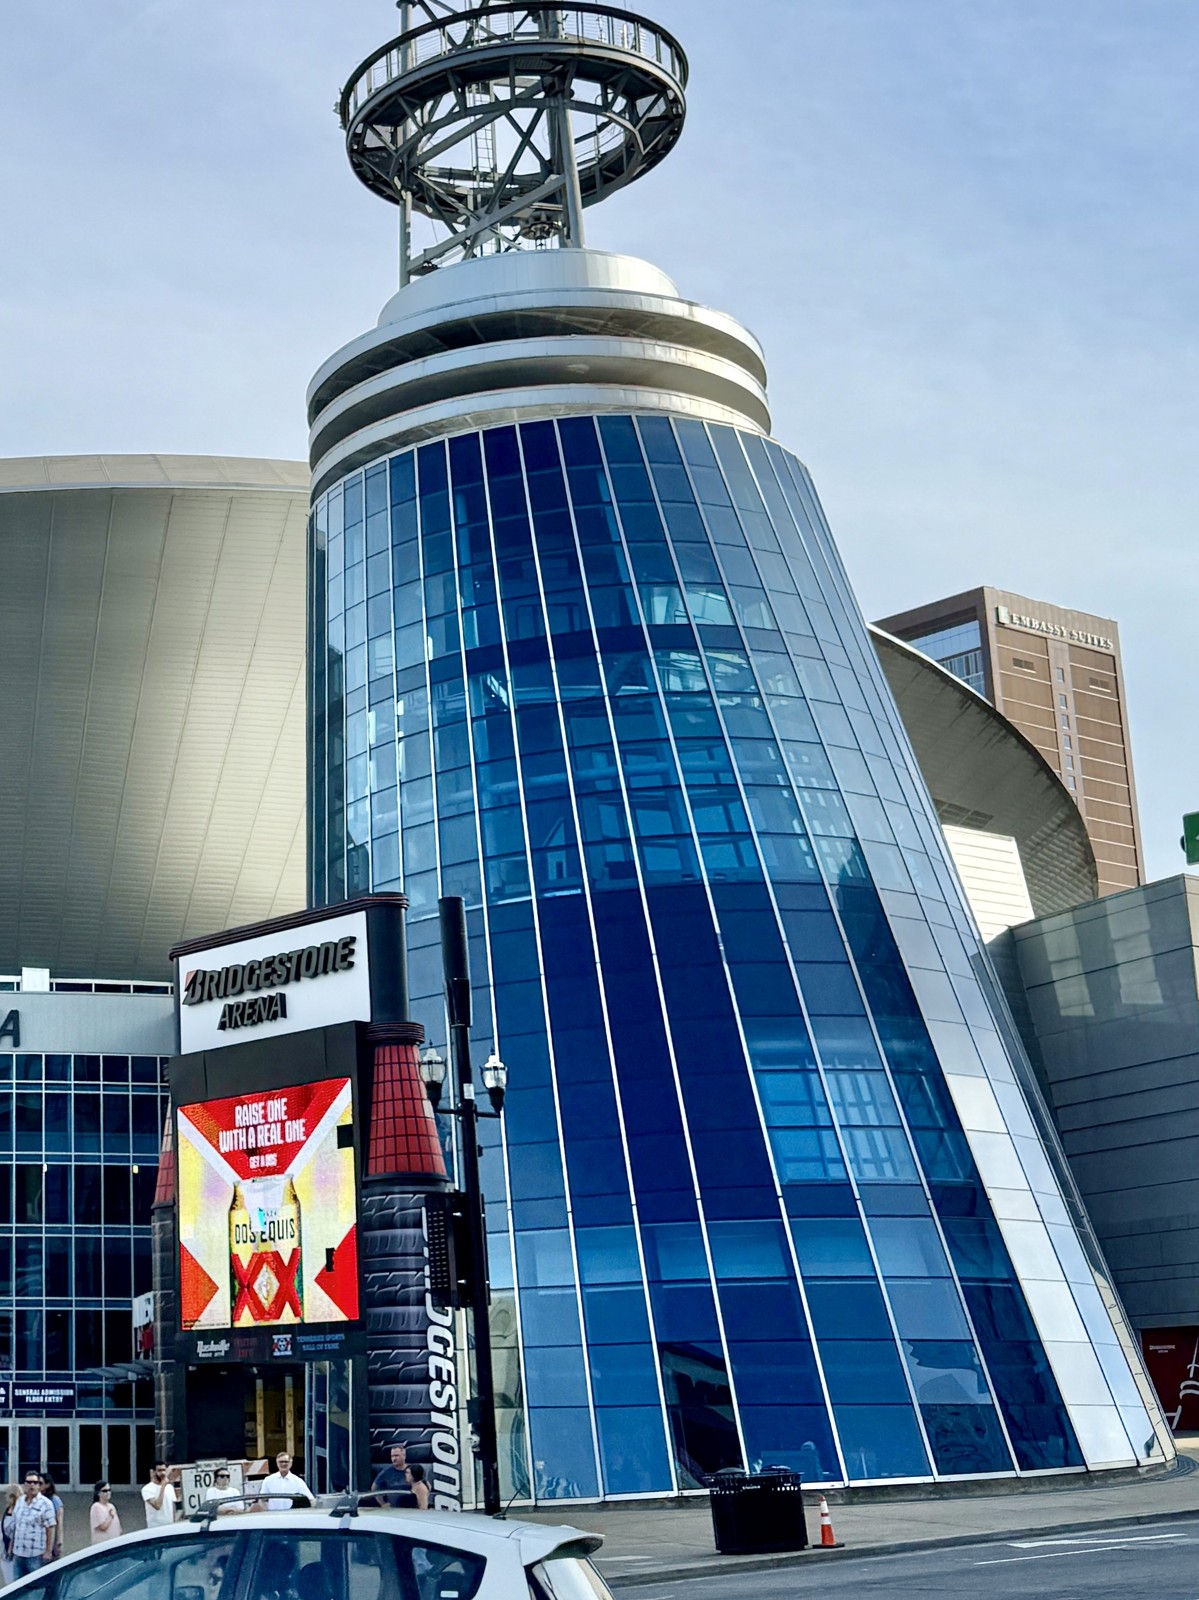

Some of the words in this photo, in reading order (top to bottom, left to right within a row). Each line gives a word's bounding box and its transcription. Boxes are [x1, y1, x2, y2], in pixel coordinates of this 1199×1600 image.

[1012, 613, 1068, 637] EMBASSY
[1069, 629, 1113, 649] SUITES
[183, 936, 357, 1005] BRIDGESTONE
[217, 992, 288, 1030] ARENA
[235, 1102, 265, 1127] RAISE
[267, 1098, 288, 1123] ONE
[219, 1127, 247, 1153] WITH
[247, 1127, 256, 1149] A
[257, 1123, 284, 1147] REAL
[285, 1119, 307, 1143] ONE
